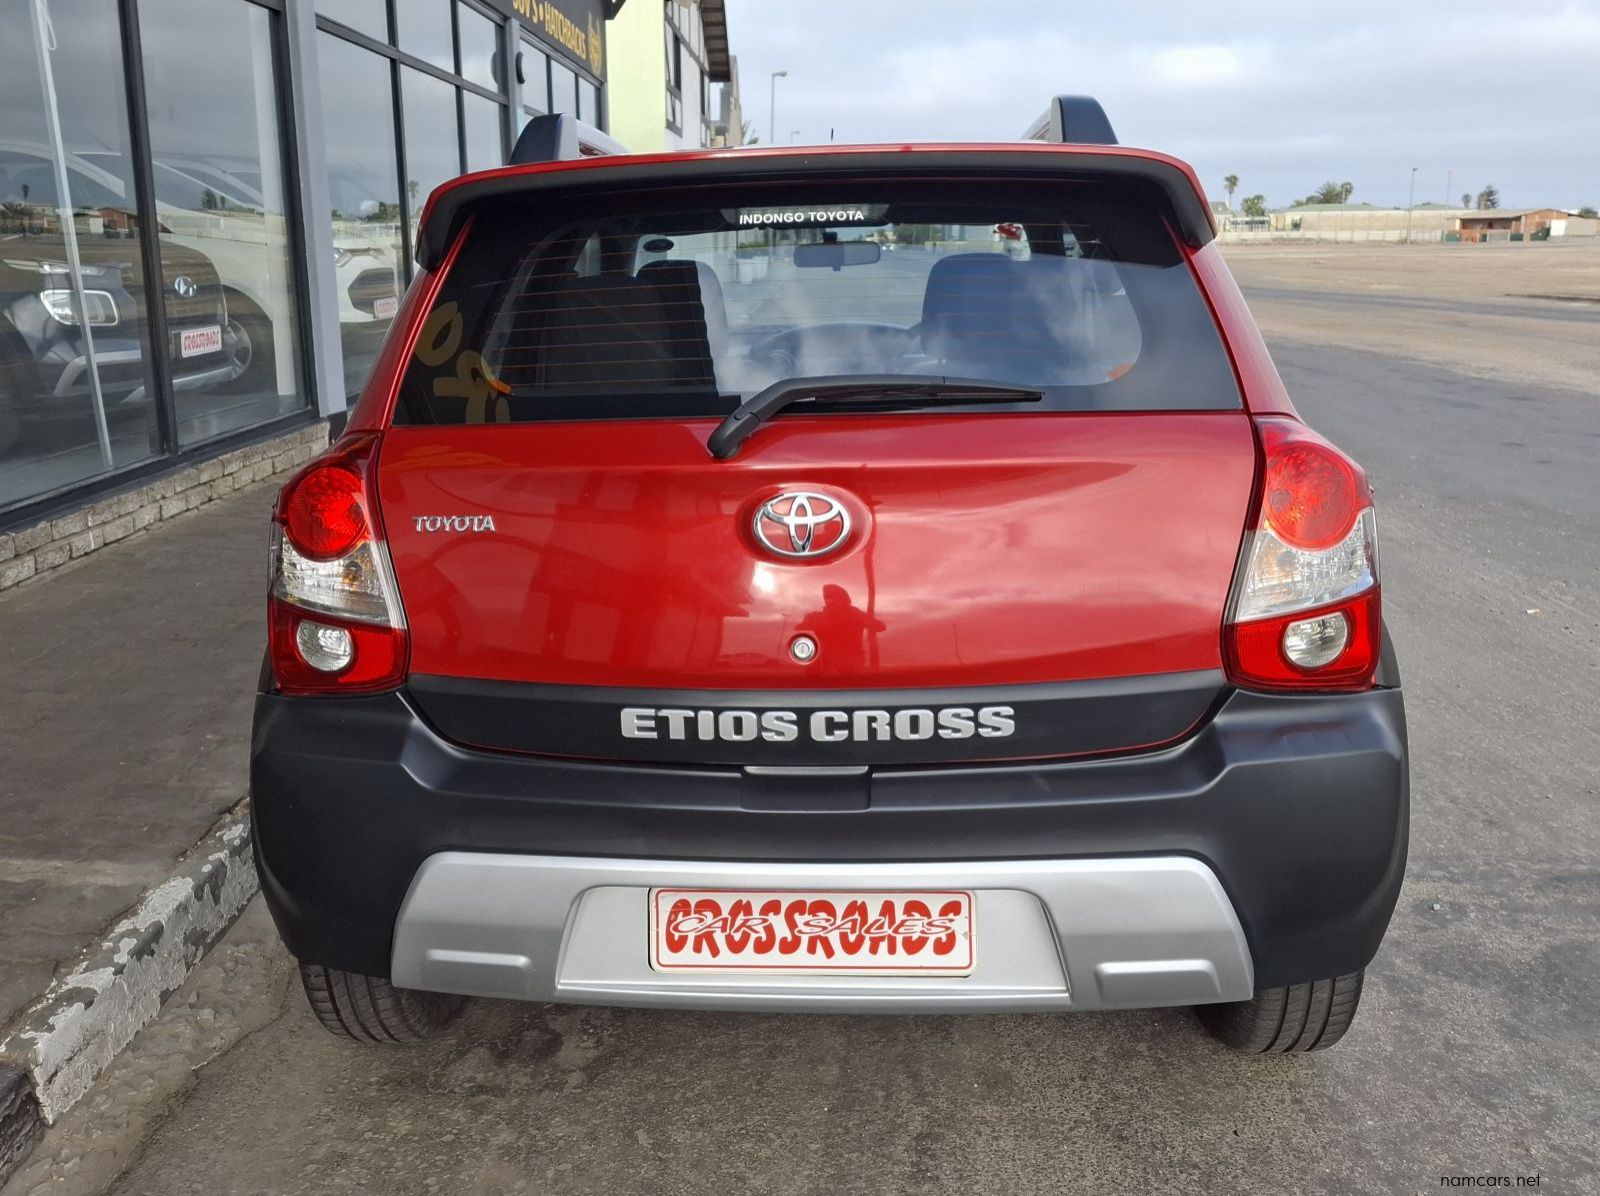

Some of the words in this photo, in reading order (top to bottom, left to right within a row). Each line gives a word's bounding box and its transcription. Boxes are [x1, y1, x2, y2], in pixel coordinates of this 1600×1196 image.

[544, 1, 586, 60] HATCHBACKS
[739, 212, 804, 225] INDONGO
[808, 210, 865, 222] TOYOTA
[412, 514, 496, 533] TOYOTA
[620, 708, 799, 741] ETIOS
[809, 706, 1016, 741] CROSS
[665, 898, 962, 960] CROSSROADS
[670, 915, 770, 935] CAR
[796, 915, 955, 936] SALES
